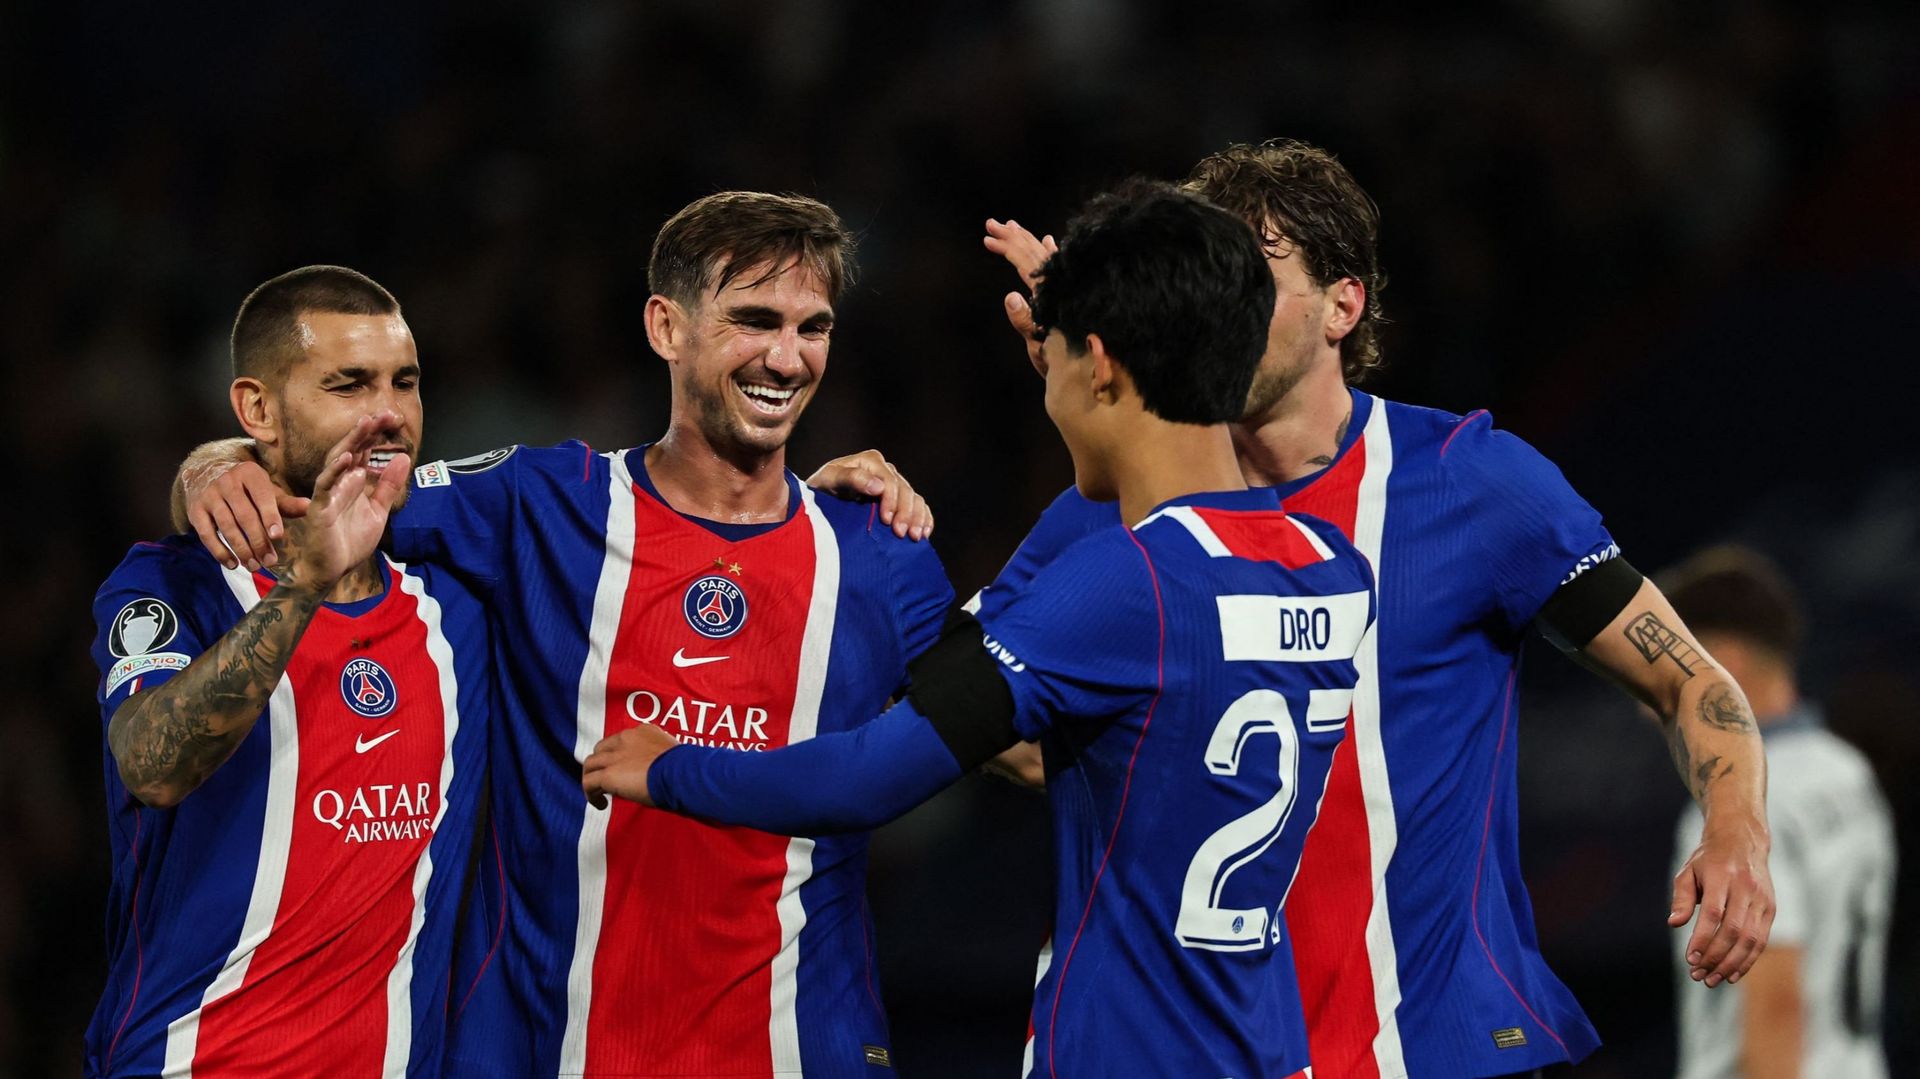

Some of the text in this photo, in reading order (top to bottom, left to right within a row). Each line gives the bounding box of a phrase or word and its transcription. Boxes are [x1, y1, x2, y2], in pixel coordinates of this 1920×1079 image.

[699, 580, 739, 599] PARIS
[1280, 607, 1331, 650] DRO
[346, 662, 379, 677] PARIS
[626, 690, 769, 740] QATAR
[312, 782, 431, 830] QATAR
[344, 818, 431, 843] AIRWAYS
